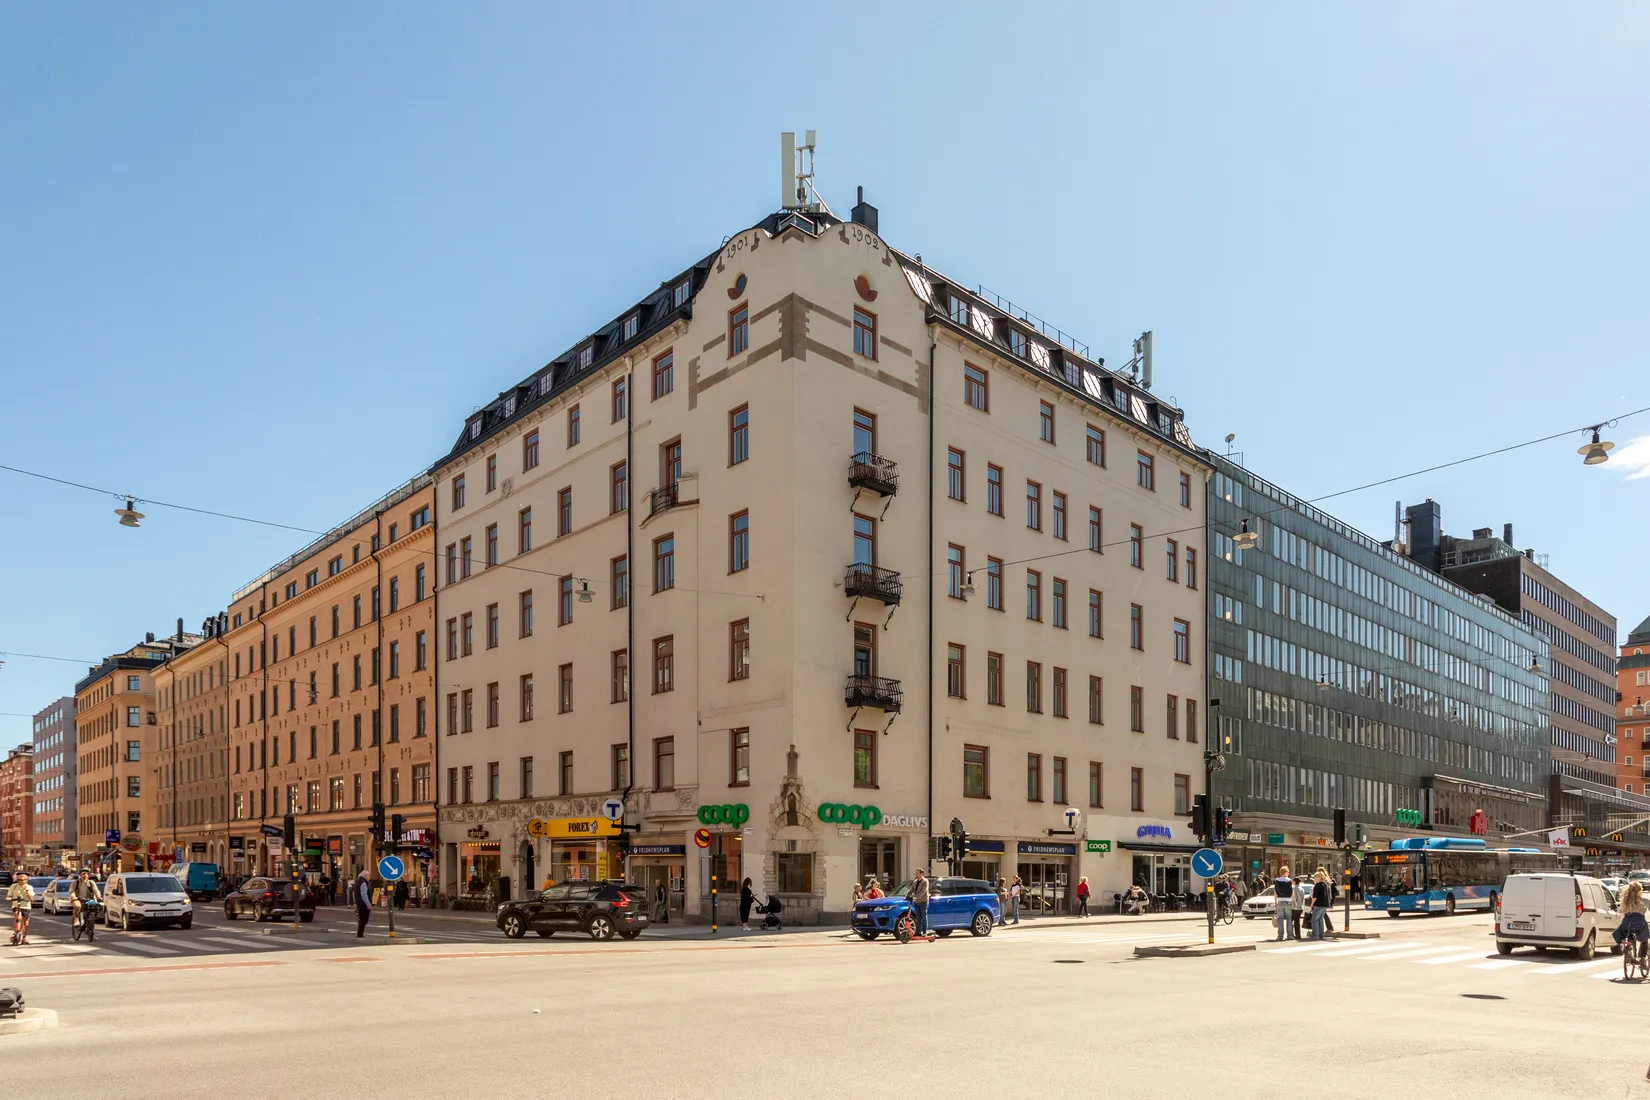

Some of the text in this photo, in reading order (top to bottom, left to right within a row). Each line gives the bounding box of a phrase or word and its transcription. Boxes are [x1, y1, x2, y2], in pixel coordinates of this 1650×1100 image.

[726, 235, 749, 259] 1901
[852, 226, 879, 250] 1902
[607, 803, 620, 818] T
[698, 803, 749, 829] coop
[817, 802, 928, 830] coop DAGLIVS
[1065, 812, 1075, 826] T
[1396, 808, 1422, 828] coop
[568, 822, 590, 833] FOREX
[1374, 855, 1379, 864] 3
